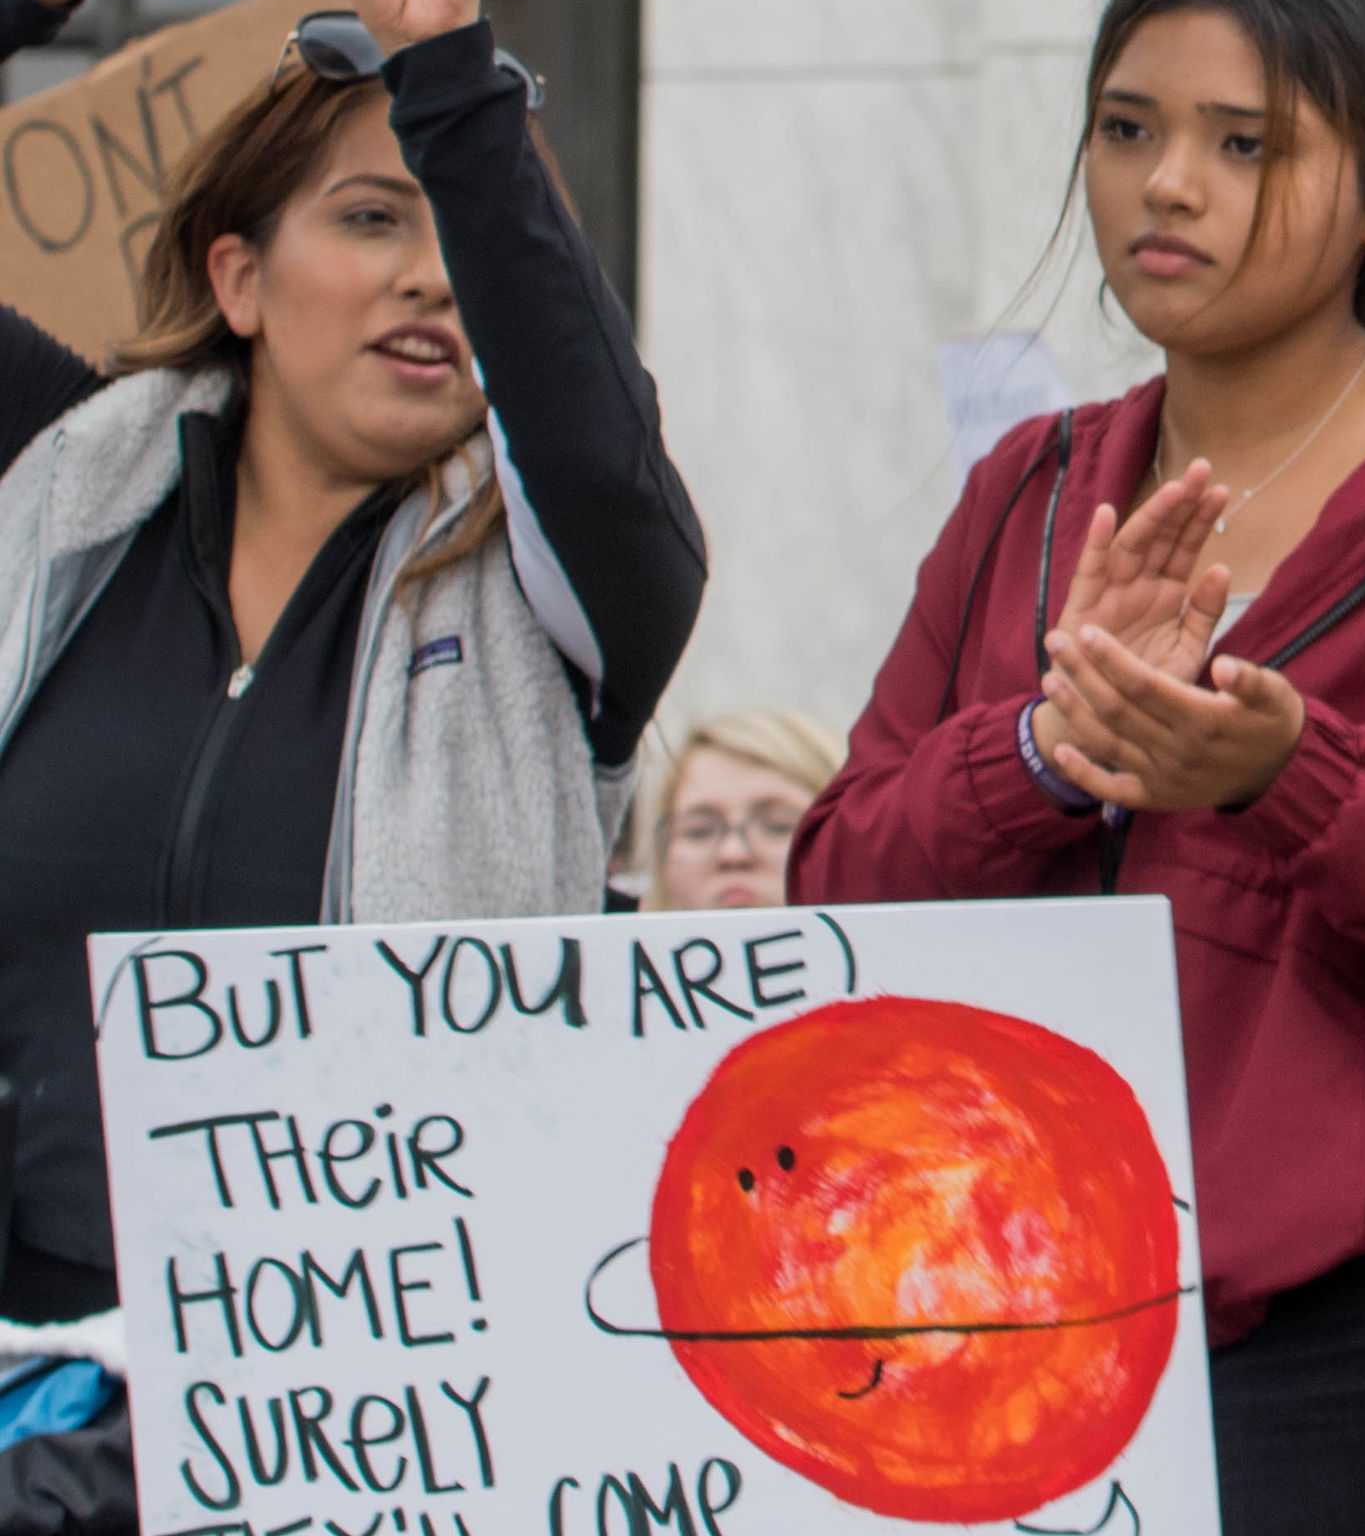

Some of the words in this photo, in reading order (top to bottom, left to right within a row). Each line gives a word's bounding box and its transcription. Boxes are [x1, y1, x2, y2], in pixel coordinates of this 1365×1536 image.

[375, 935, 588, 1037] YOU
[632, 912, 858, 1038] ARE)
[166, 1216, 489, 1358] HOME!
